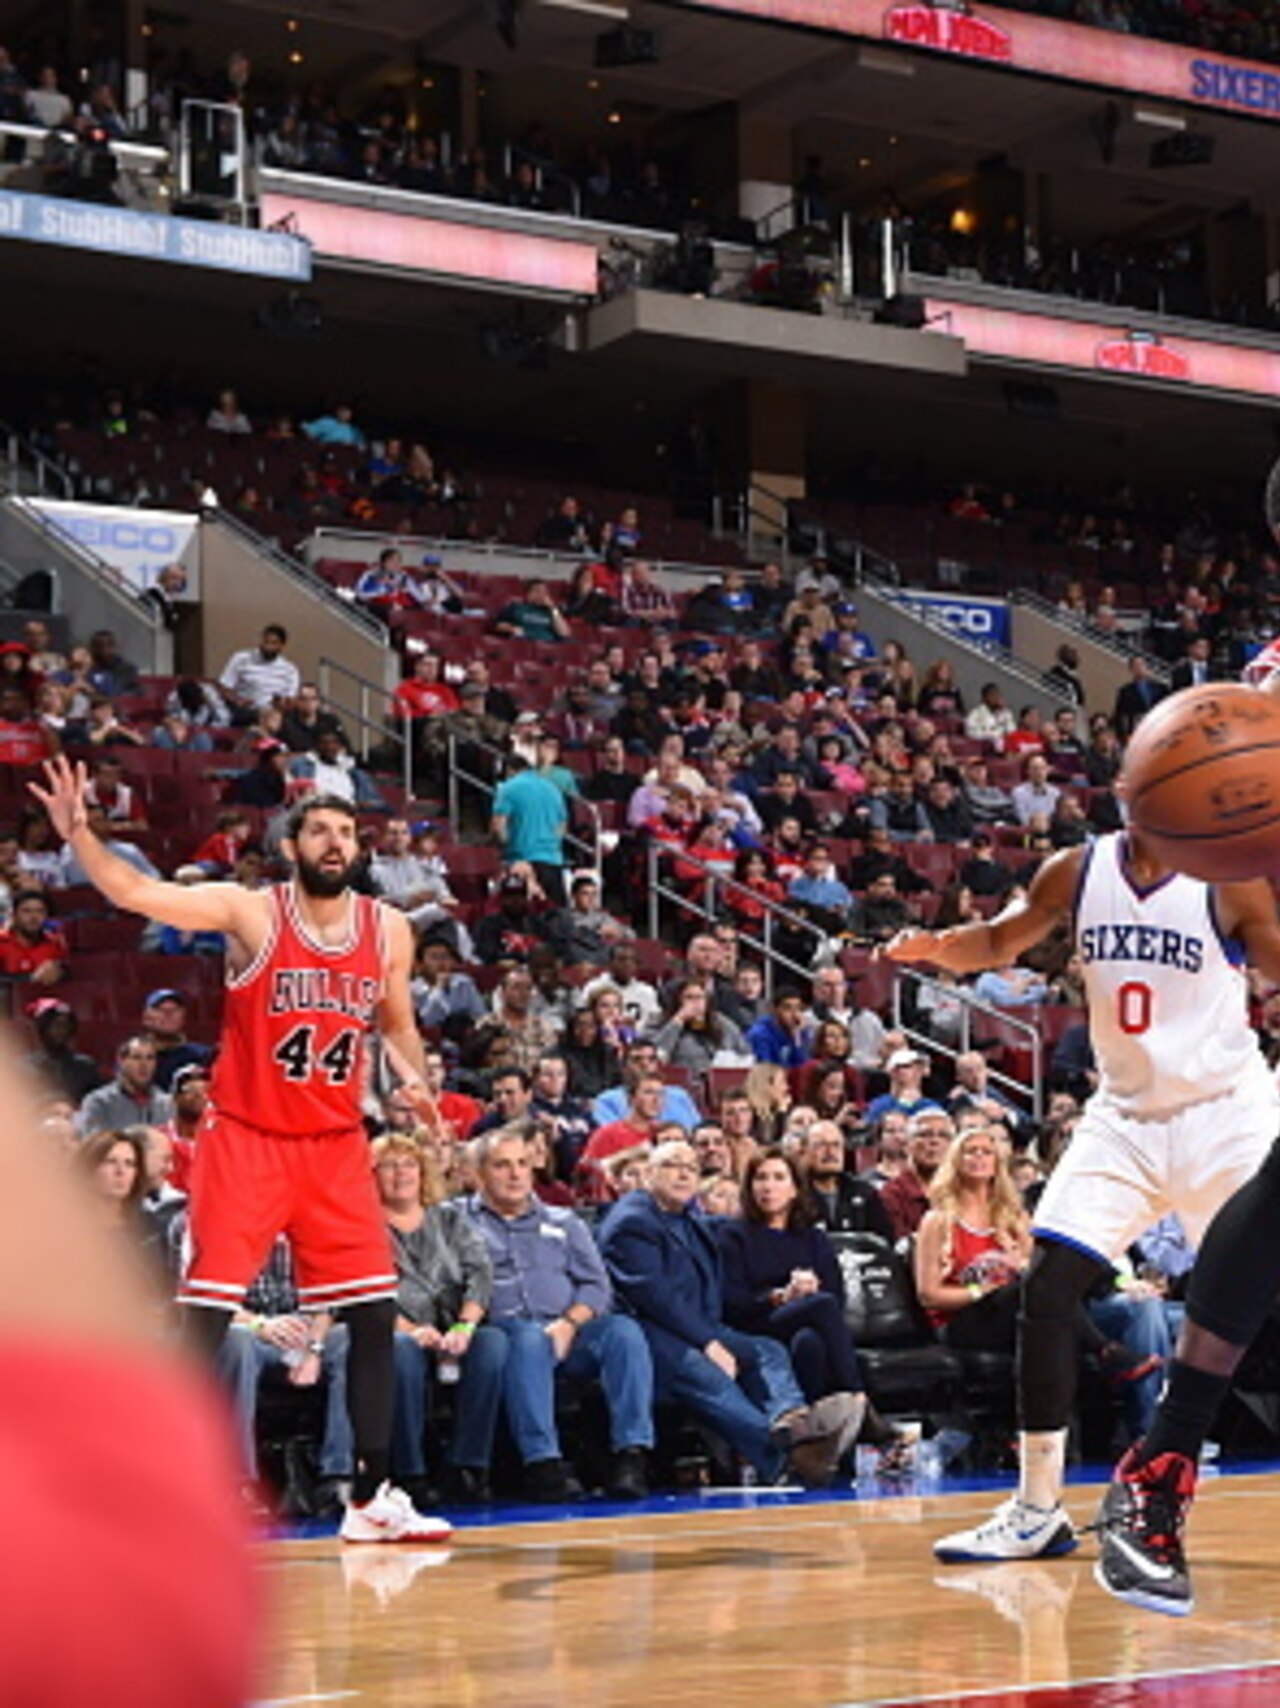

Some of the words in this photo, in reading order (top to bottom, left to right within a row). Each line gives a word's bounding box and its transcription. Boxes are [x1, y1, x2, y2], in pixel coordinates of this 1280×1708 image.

[41, 205, 167, 251] StubHub!
[180, 226, 300, 273] StubHub!
[1081, 924, 1204, 974] SIXERS
[1118, 980, 1153, 1035] 0
[272, 1024, 360, 1086] 44
